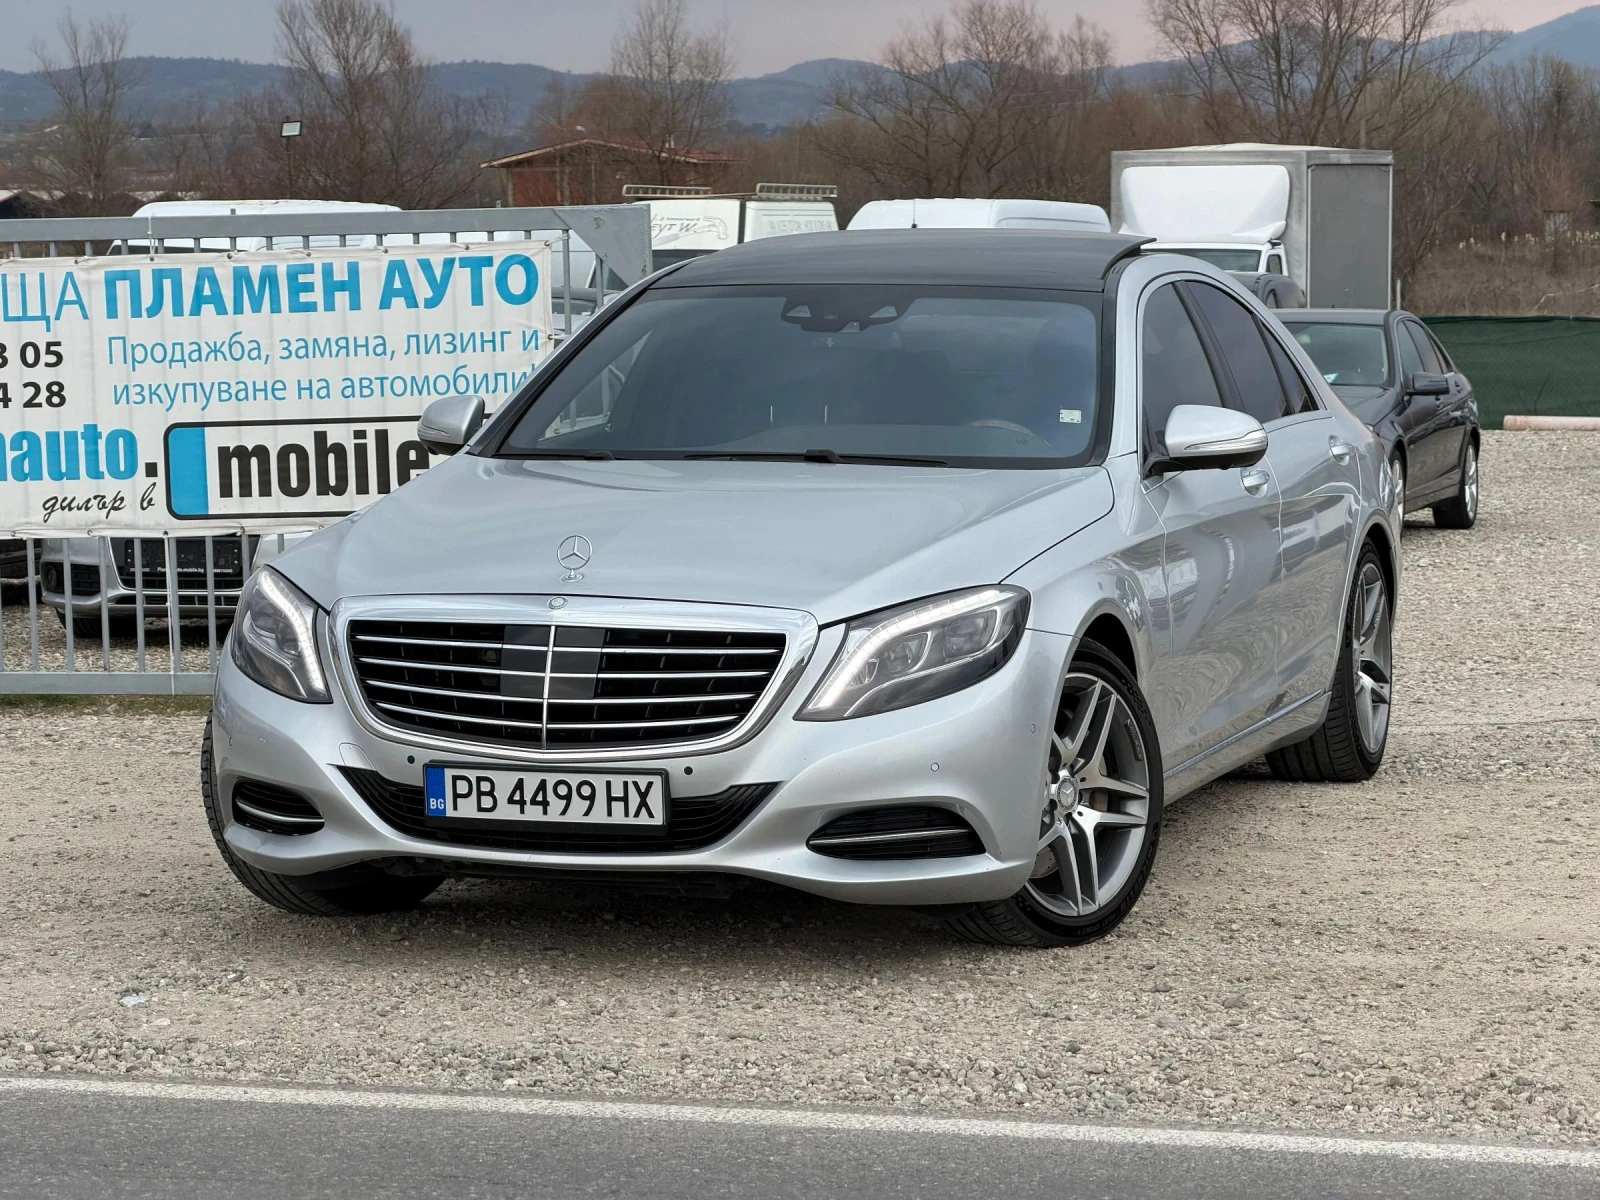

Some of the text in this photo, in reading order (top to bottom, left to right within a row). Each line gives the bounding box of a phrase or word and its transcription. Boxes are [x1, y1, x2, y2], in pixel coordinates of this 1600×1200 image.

[104, 261, 361, 319] ПЛАМЕН
[379, 253, 540, 310] АУТО
[19, 341, 64, 369] 05
[107, 329, 539, 372] Продажба, замяна, лизинг и
[22, 381, 67, 409] 28
[113, 378, 287, 412] изкупуване
[296, 376, 331, 400] на
[42, 482, 157, 523] дилър в
[429, 797, 445, 810] BG
[451, 774, 656, 819] PB 4499 HX
